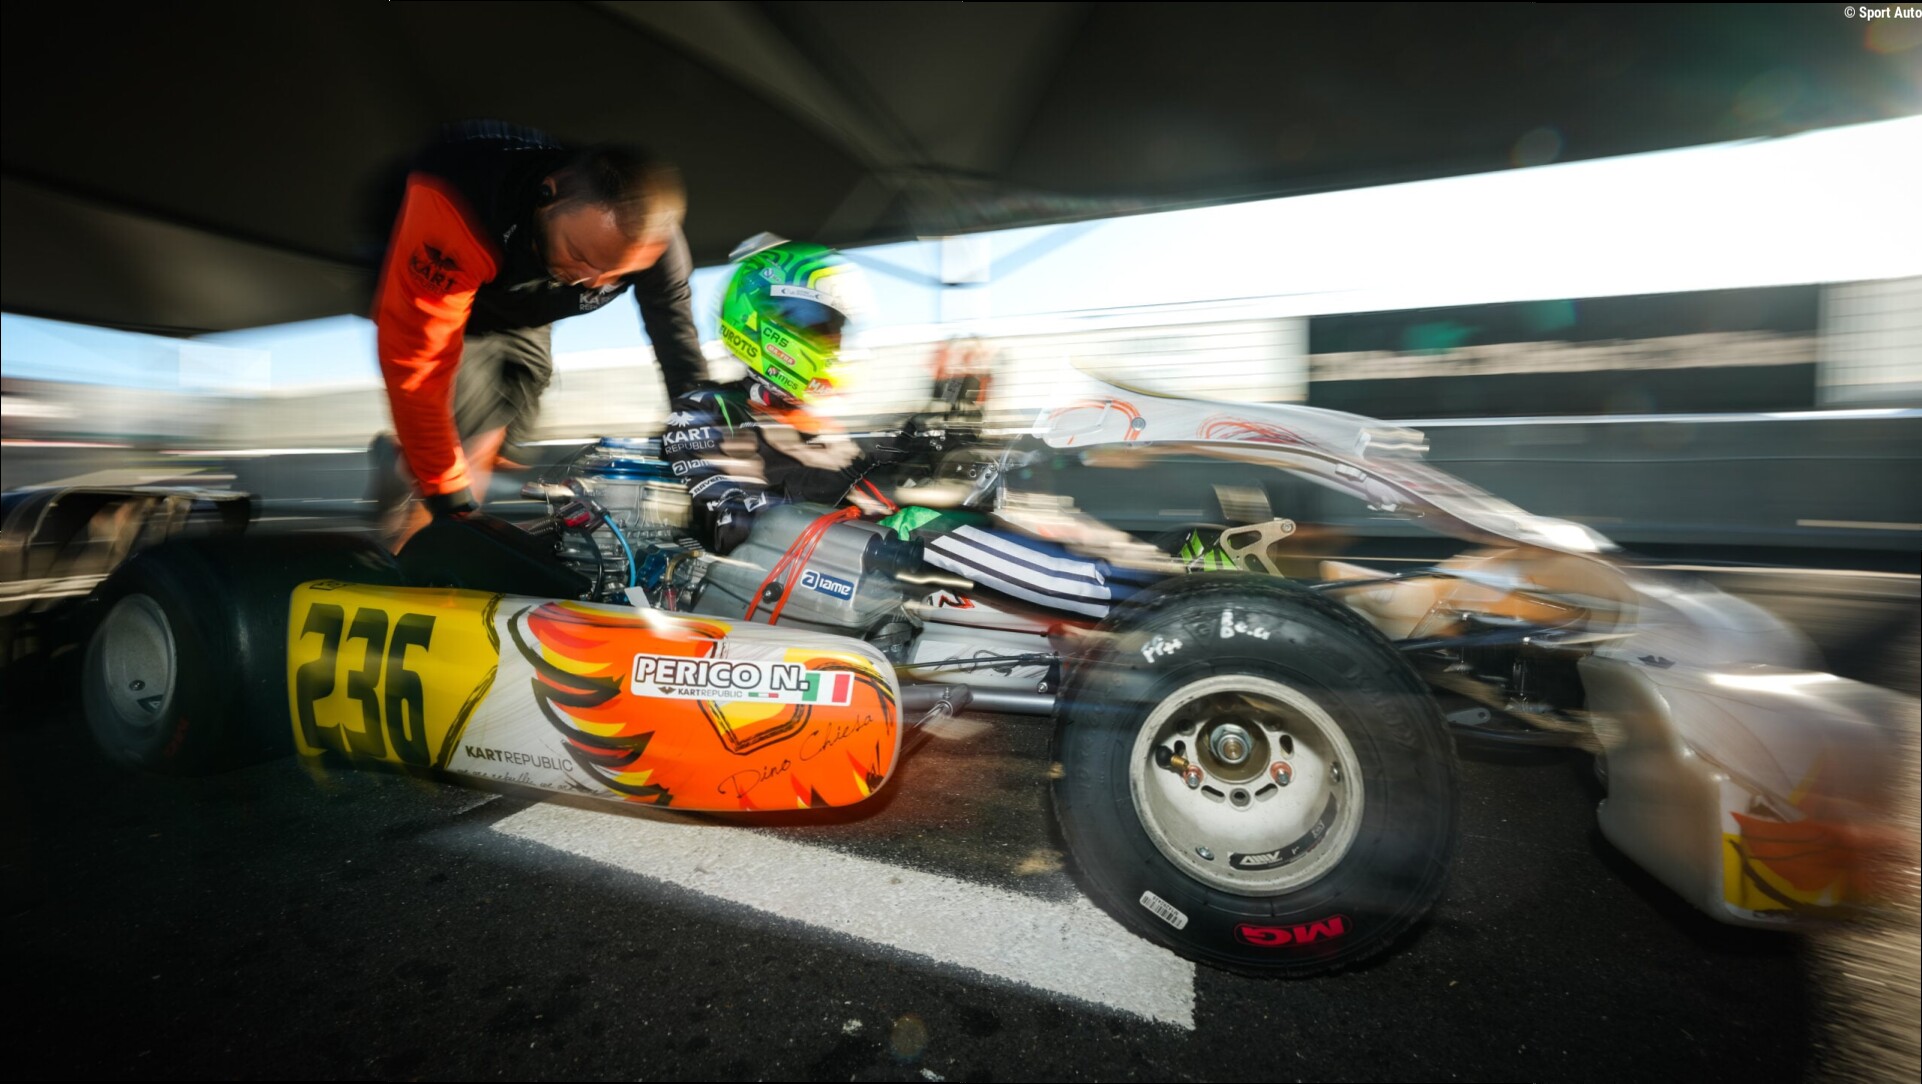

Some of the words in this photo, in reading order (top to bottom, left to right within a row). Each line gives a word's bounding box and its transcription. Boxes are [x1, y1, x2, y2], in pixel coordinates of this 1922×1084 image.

[763, 327, 789, 348] CRS
[662, 426, 710, 446] KART
[665, 439, 715, 455] REPUBLIC
[296, 602, 437, 767] 236
[634, 656, 762, 689] PERICO
[770, 664, 810, 692] N.
[717, 758, 792, 799] Dino
[800, 713, 874, 762] Chiesa
[1241, 916, 1344, 946] MG
